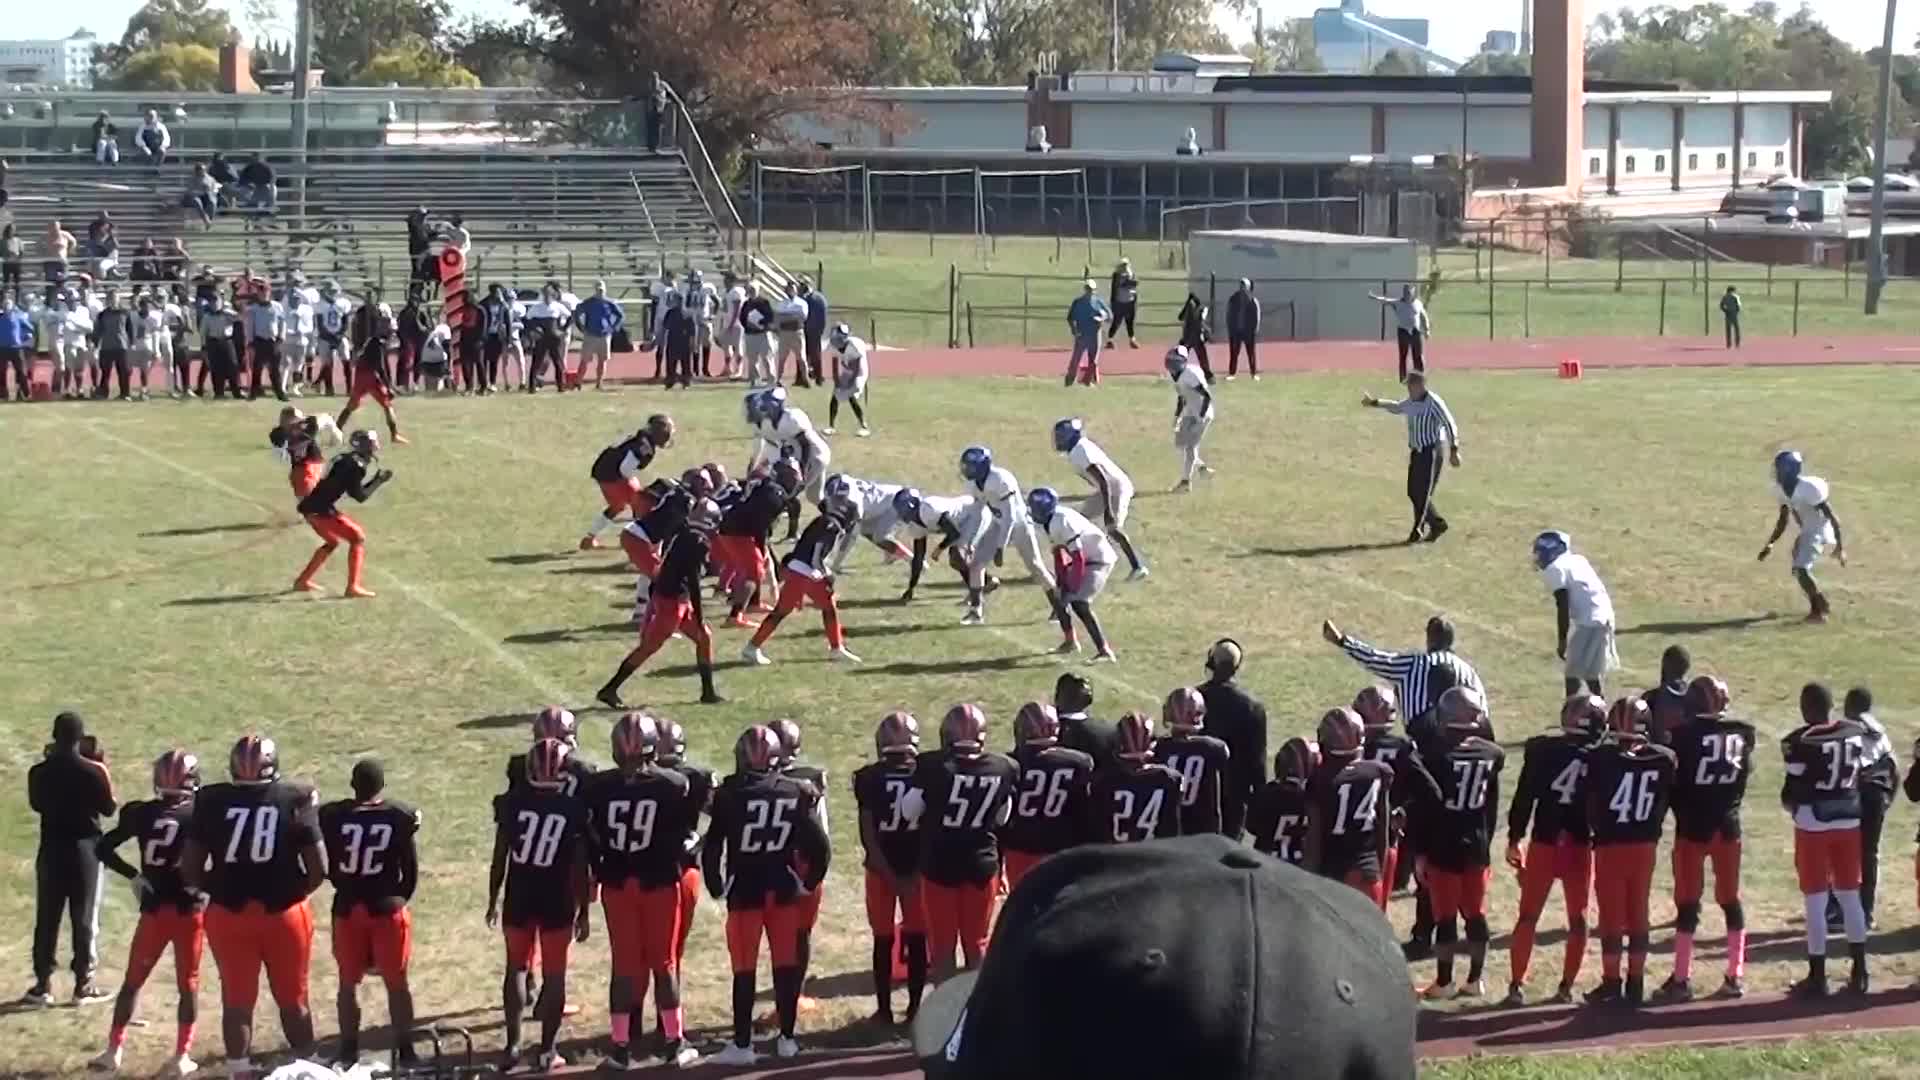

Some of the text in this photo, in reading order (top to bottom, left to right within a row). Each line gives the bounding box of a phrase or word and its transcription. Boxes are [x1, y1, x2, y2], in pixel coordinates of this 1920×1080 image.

[942, 773, 1001, 828] 57
[1018, 768, 1075, 818] 26
[1332, 778, 1381, 835] 14
[1551, 758, 1588, 804] 4
[1609, 771, 1658, 823] 46
[225, 806, 279, 863] 78
[512, 810, 566, 866] 38
[607, 800, 657, 852] 59
[740, 798, 798, 852] 25
[1113, 789, 1164, 842] 24
[1273, 815, 1309, 860] 5
[338, 823, 393, 875] 32
